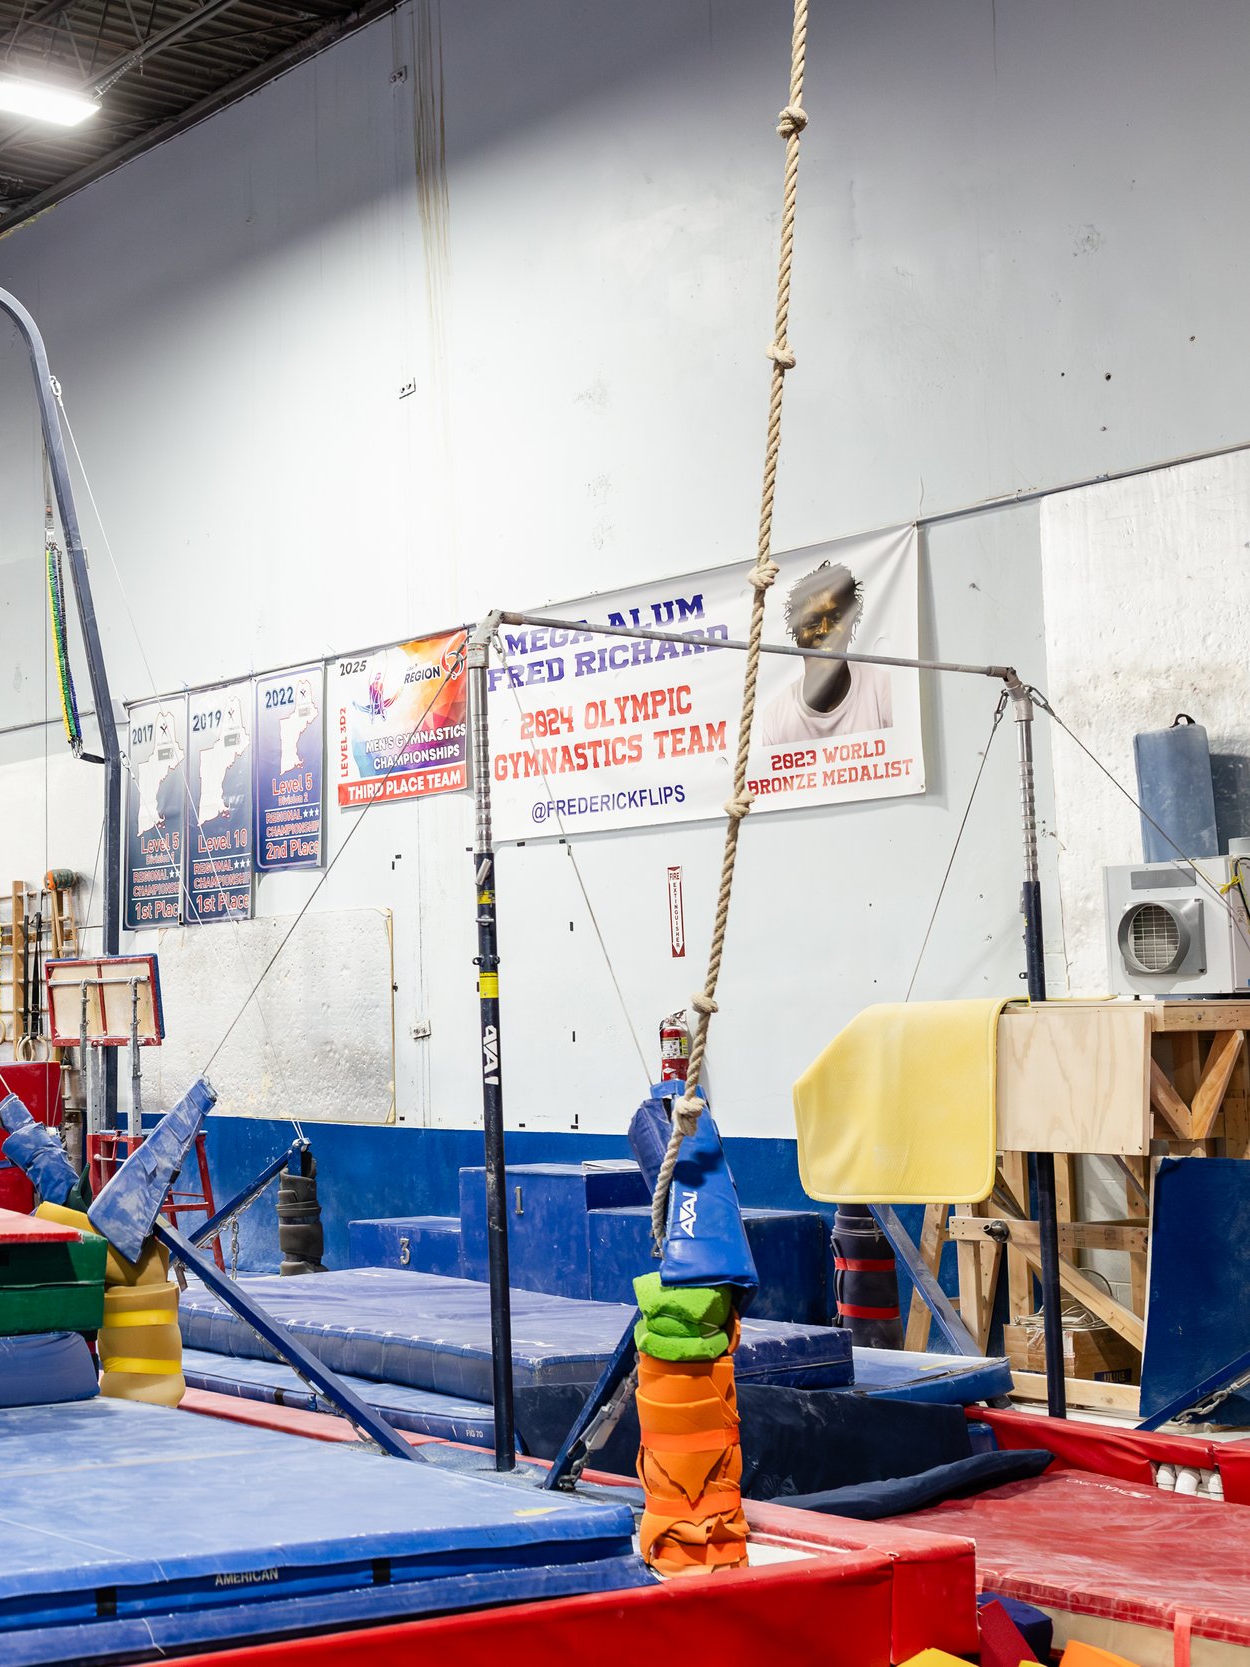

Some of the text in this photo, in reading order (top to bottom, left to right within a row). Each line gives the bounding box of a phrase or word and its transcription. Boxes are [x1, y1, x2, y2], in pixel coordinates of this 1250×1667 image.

[505, 593, 706, 656] MEGA ALUM
[339, 660, 368, 677] 2025
[487, 624, 728, 692] FRED RICHARD
[403, 665, 441, 685] REGION
[265, 686, 294, 708] 2022
[192, 709, 222, 732] 2019
[520, 684, 692, 740] 2024 OLYMPIC
[132, 724, 154, 745] 2017
[339, 707, 349, 778] LEVEL 3D2
[365, 724, 466, 754] MEN'S GYMNASTICS
[373, 744, 460, 771] CHAMPIONSHIPS
[494, 720, 727, 782] GYMNASTICS TEAM
[771, 739, 886, 771] 2023 WORLD
[272, 773, 313, 797] Level 5
[348, 769, 461, 800] THIRD PLACE TEAM
[747, 759, 913, 796] BRONZE MEDALIST
[278, 794, 303, 807] Division
[531, 784, 686, 824] @FREDERICKFLIPS
[266, 809, 303, 824] REGIONAL
[141, 831, 180, 854] Level 5
[197, 828, 248, 852] Level 10
[266, 839, 288, 860] 2nd
[193, 860, 233, 875] REGIONAL
[135, 903, 153, 921] 1st
[196, 893, 250, 913] 1st Place
[514, 1186, 524, 1215] 1
[399, 1237, 410, 1265] 3
[215, 1568, 279, 1587] AMERICAN
